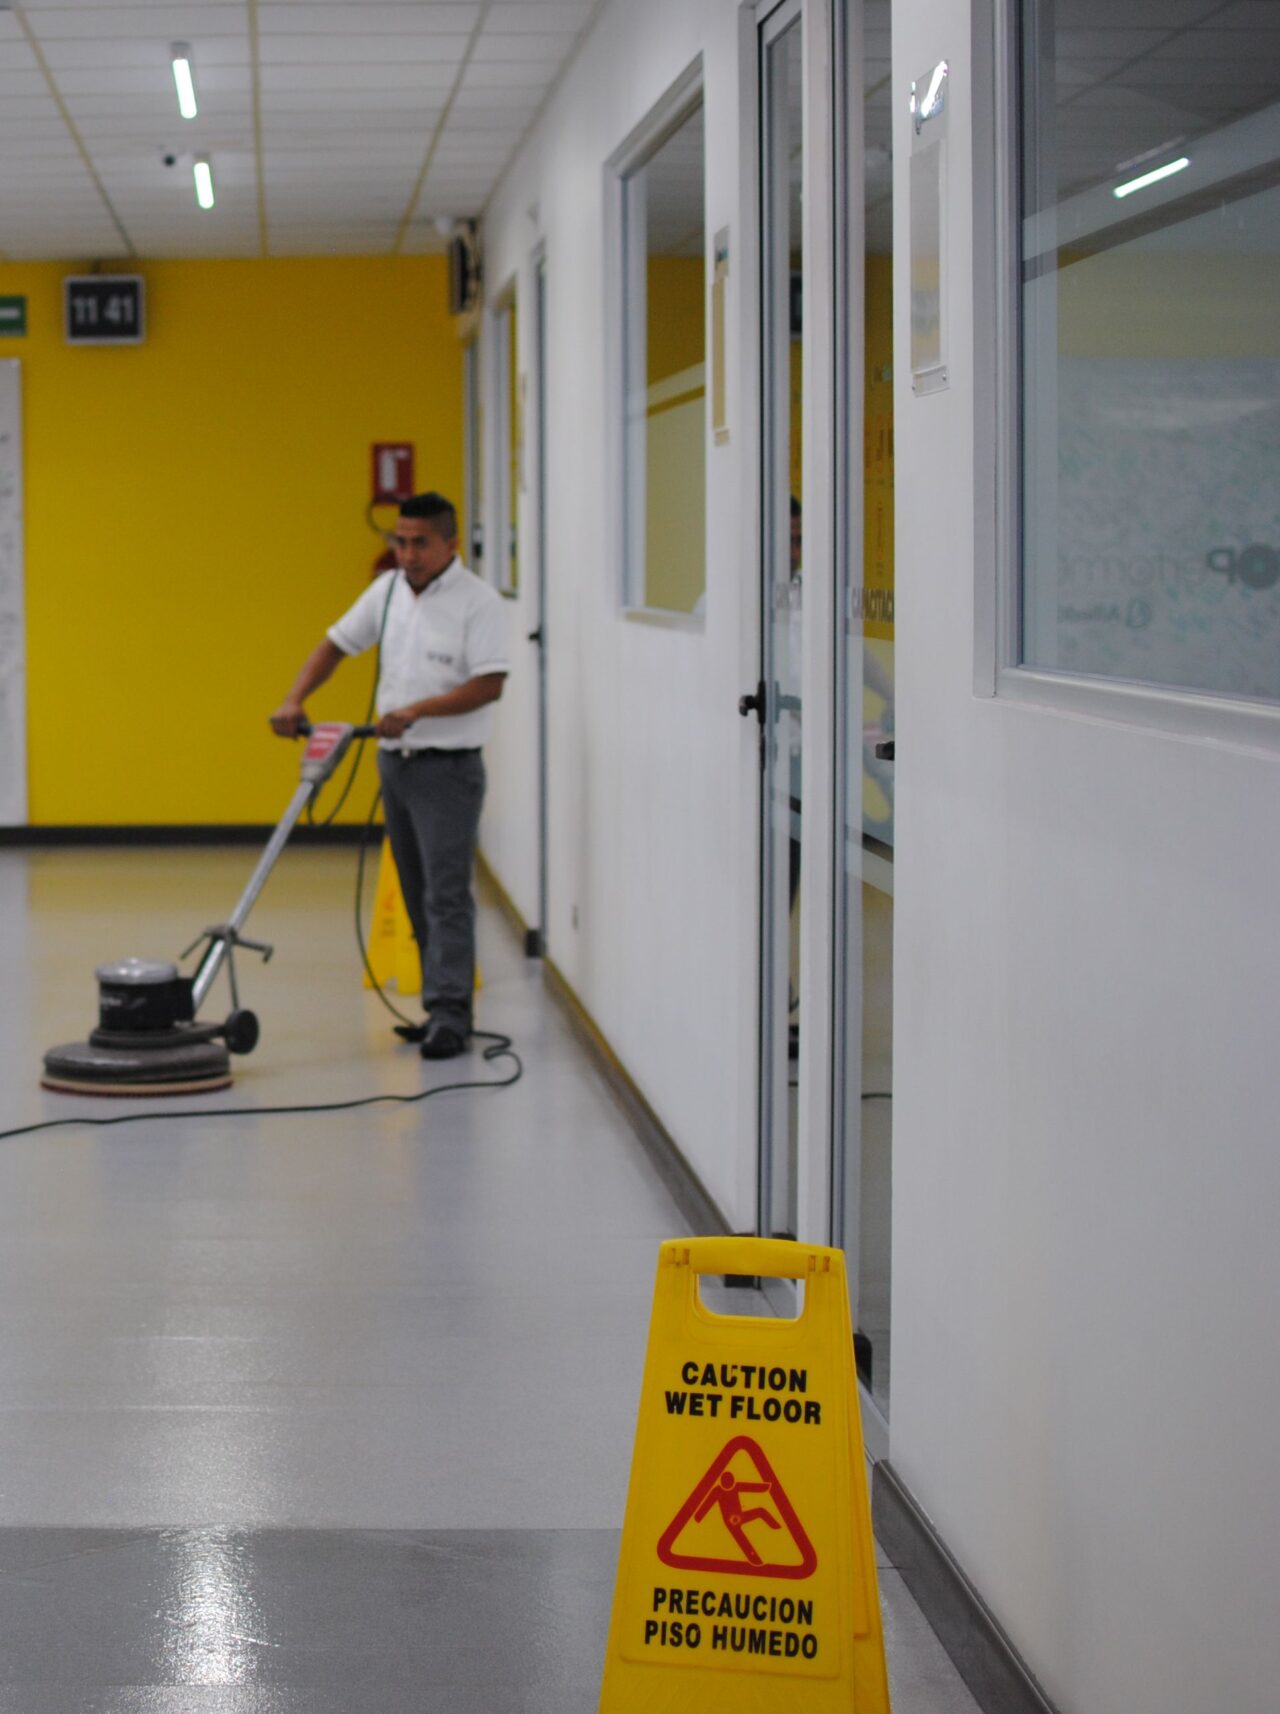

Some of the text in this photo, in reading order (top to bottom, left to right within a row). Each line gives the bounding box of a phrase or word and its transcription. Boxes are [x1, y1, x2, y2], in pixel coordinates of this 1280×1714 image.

[682, 1361, 807, 1392] CAUTION
[665, 1391, 821, 1425] WET FLOOR
[652, 1587, 813, 1625] PRECAUCION
[645, 1619, 818, 1660] PISO HUMEDO
